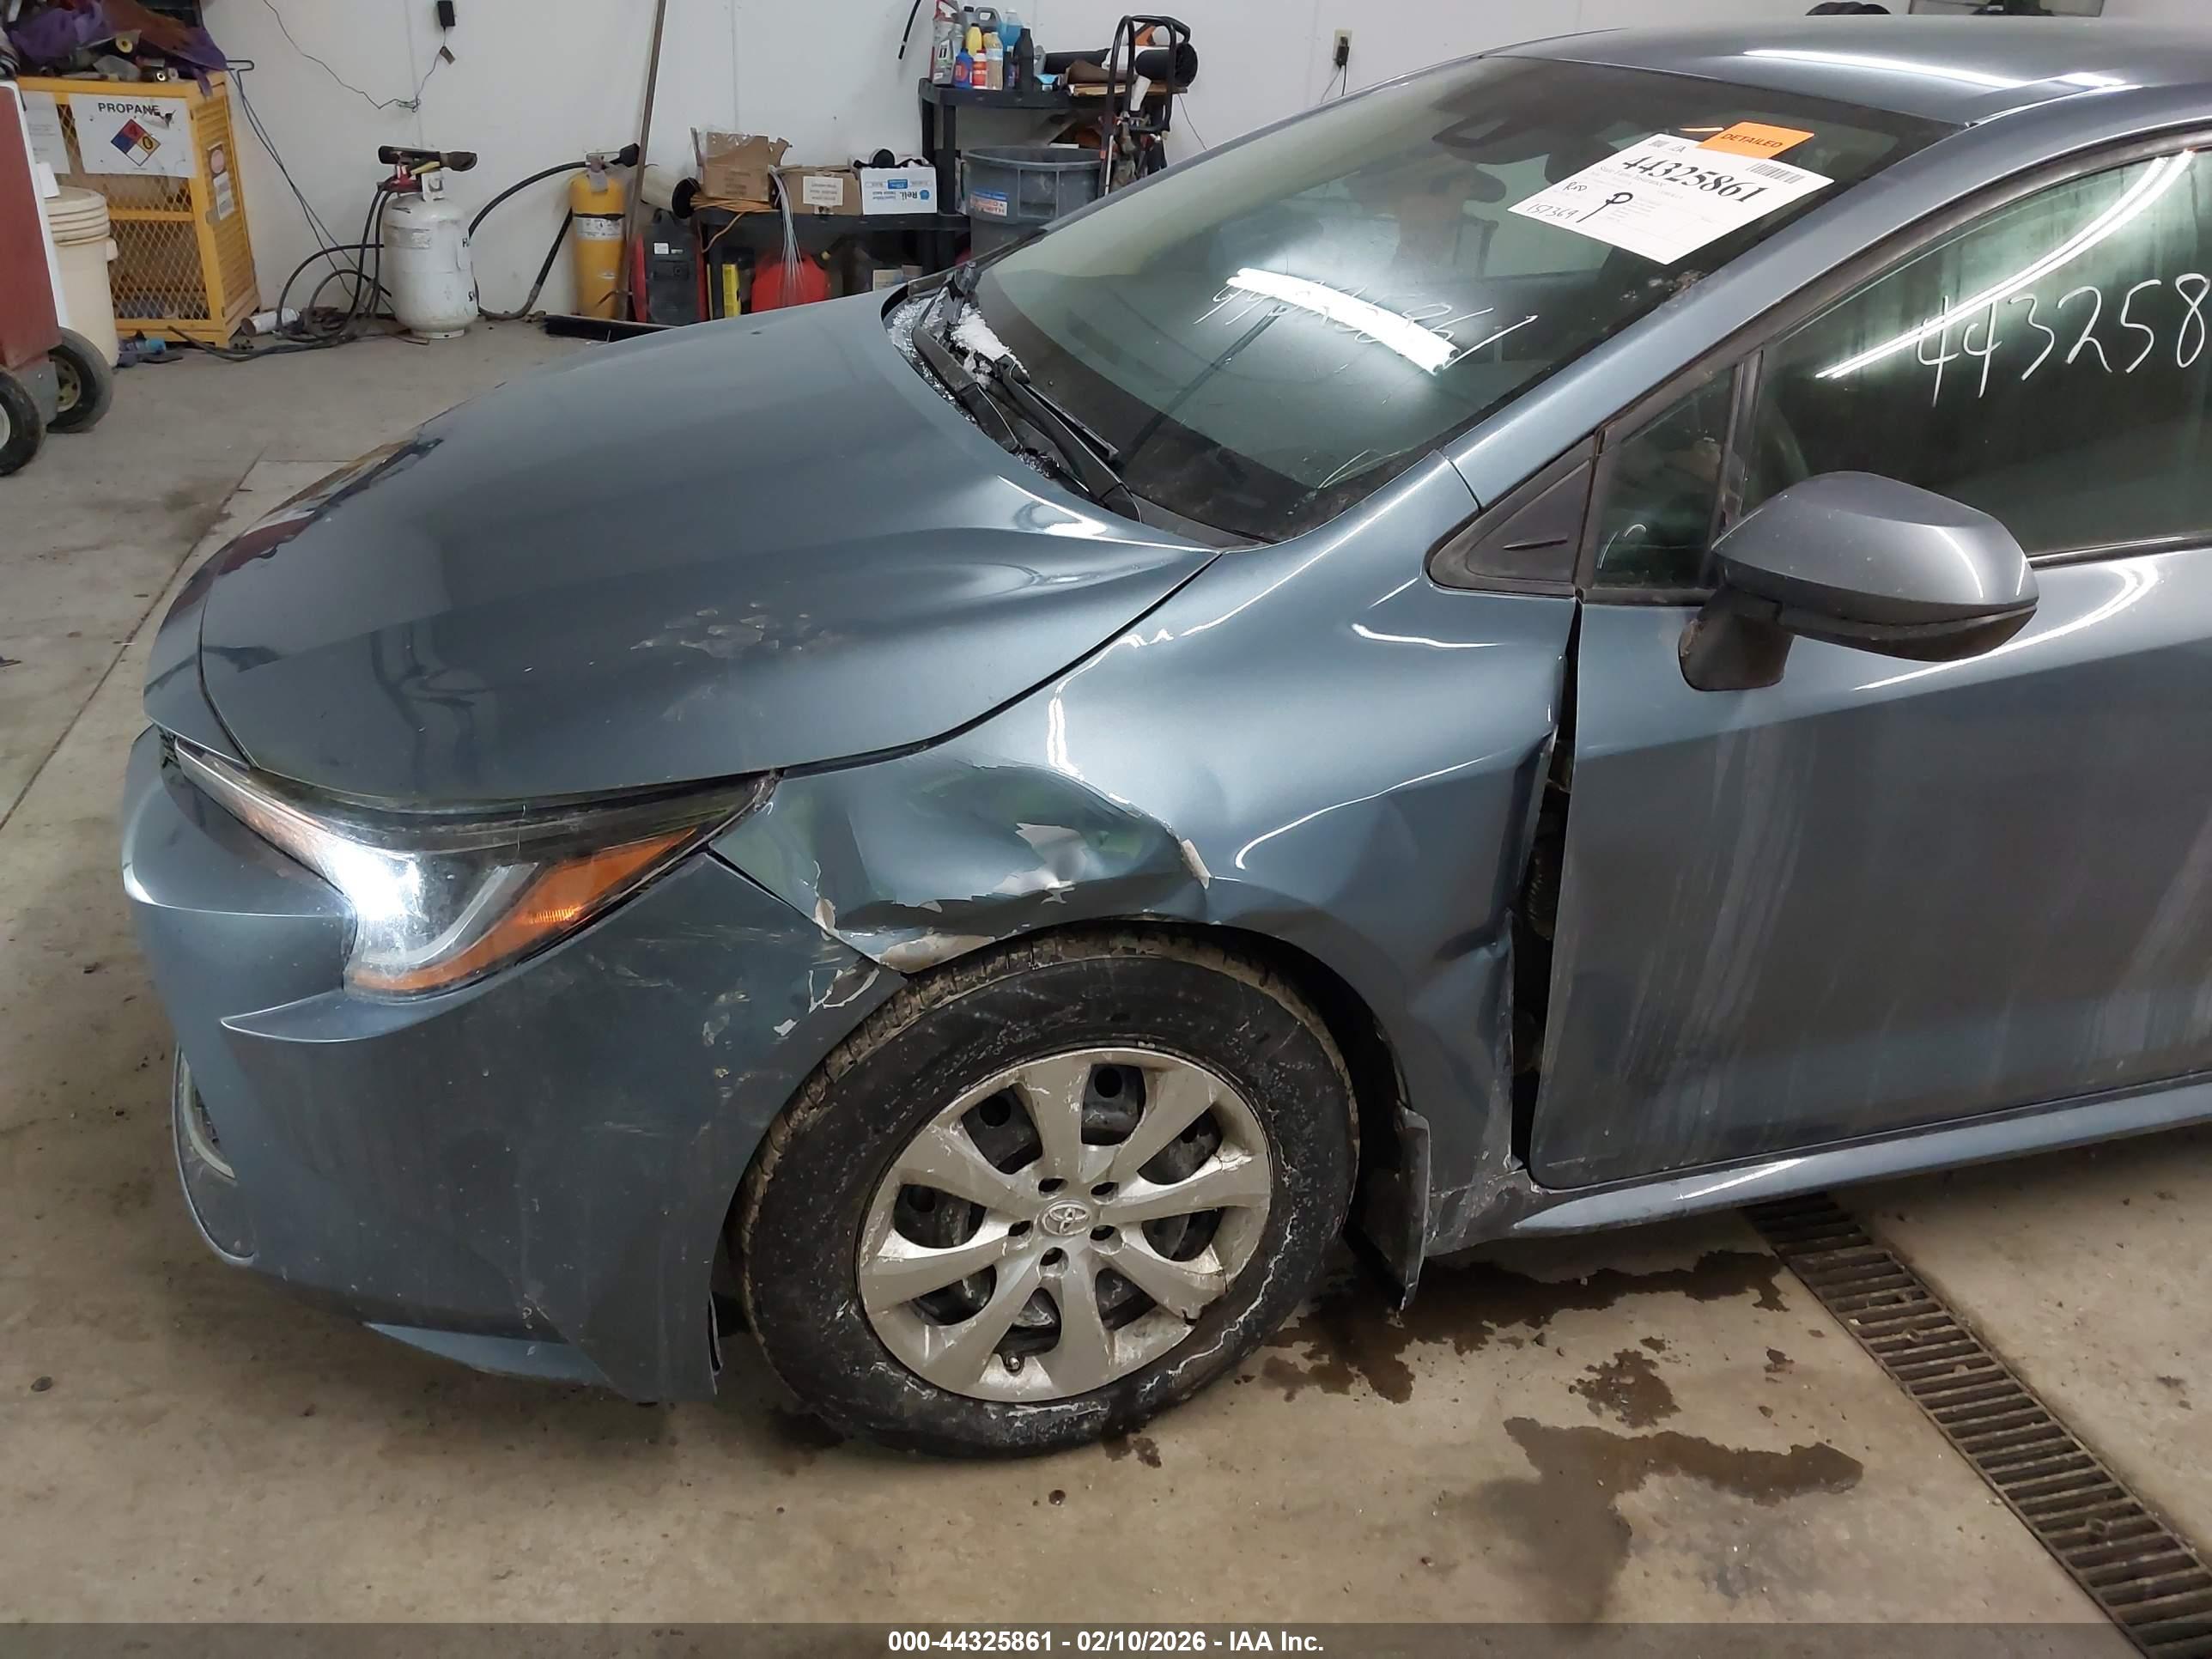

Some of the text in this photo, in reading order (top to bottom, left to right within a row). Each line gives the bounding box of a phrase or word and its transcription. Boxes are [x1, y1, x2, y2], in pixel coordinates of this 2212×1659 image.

[98, 102, 159, 115] PROPANE
[142, 136, 154, 149] 0
[1721, 132, 1783, 149] DETAILED
[1622, 155, 1768, 203] 44325861
[900, 191, 918, 200] Reli.
